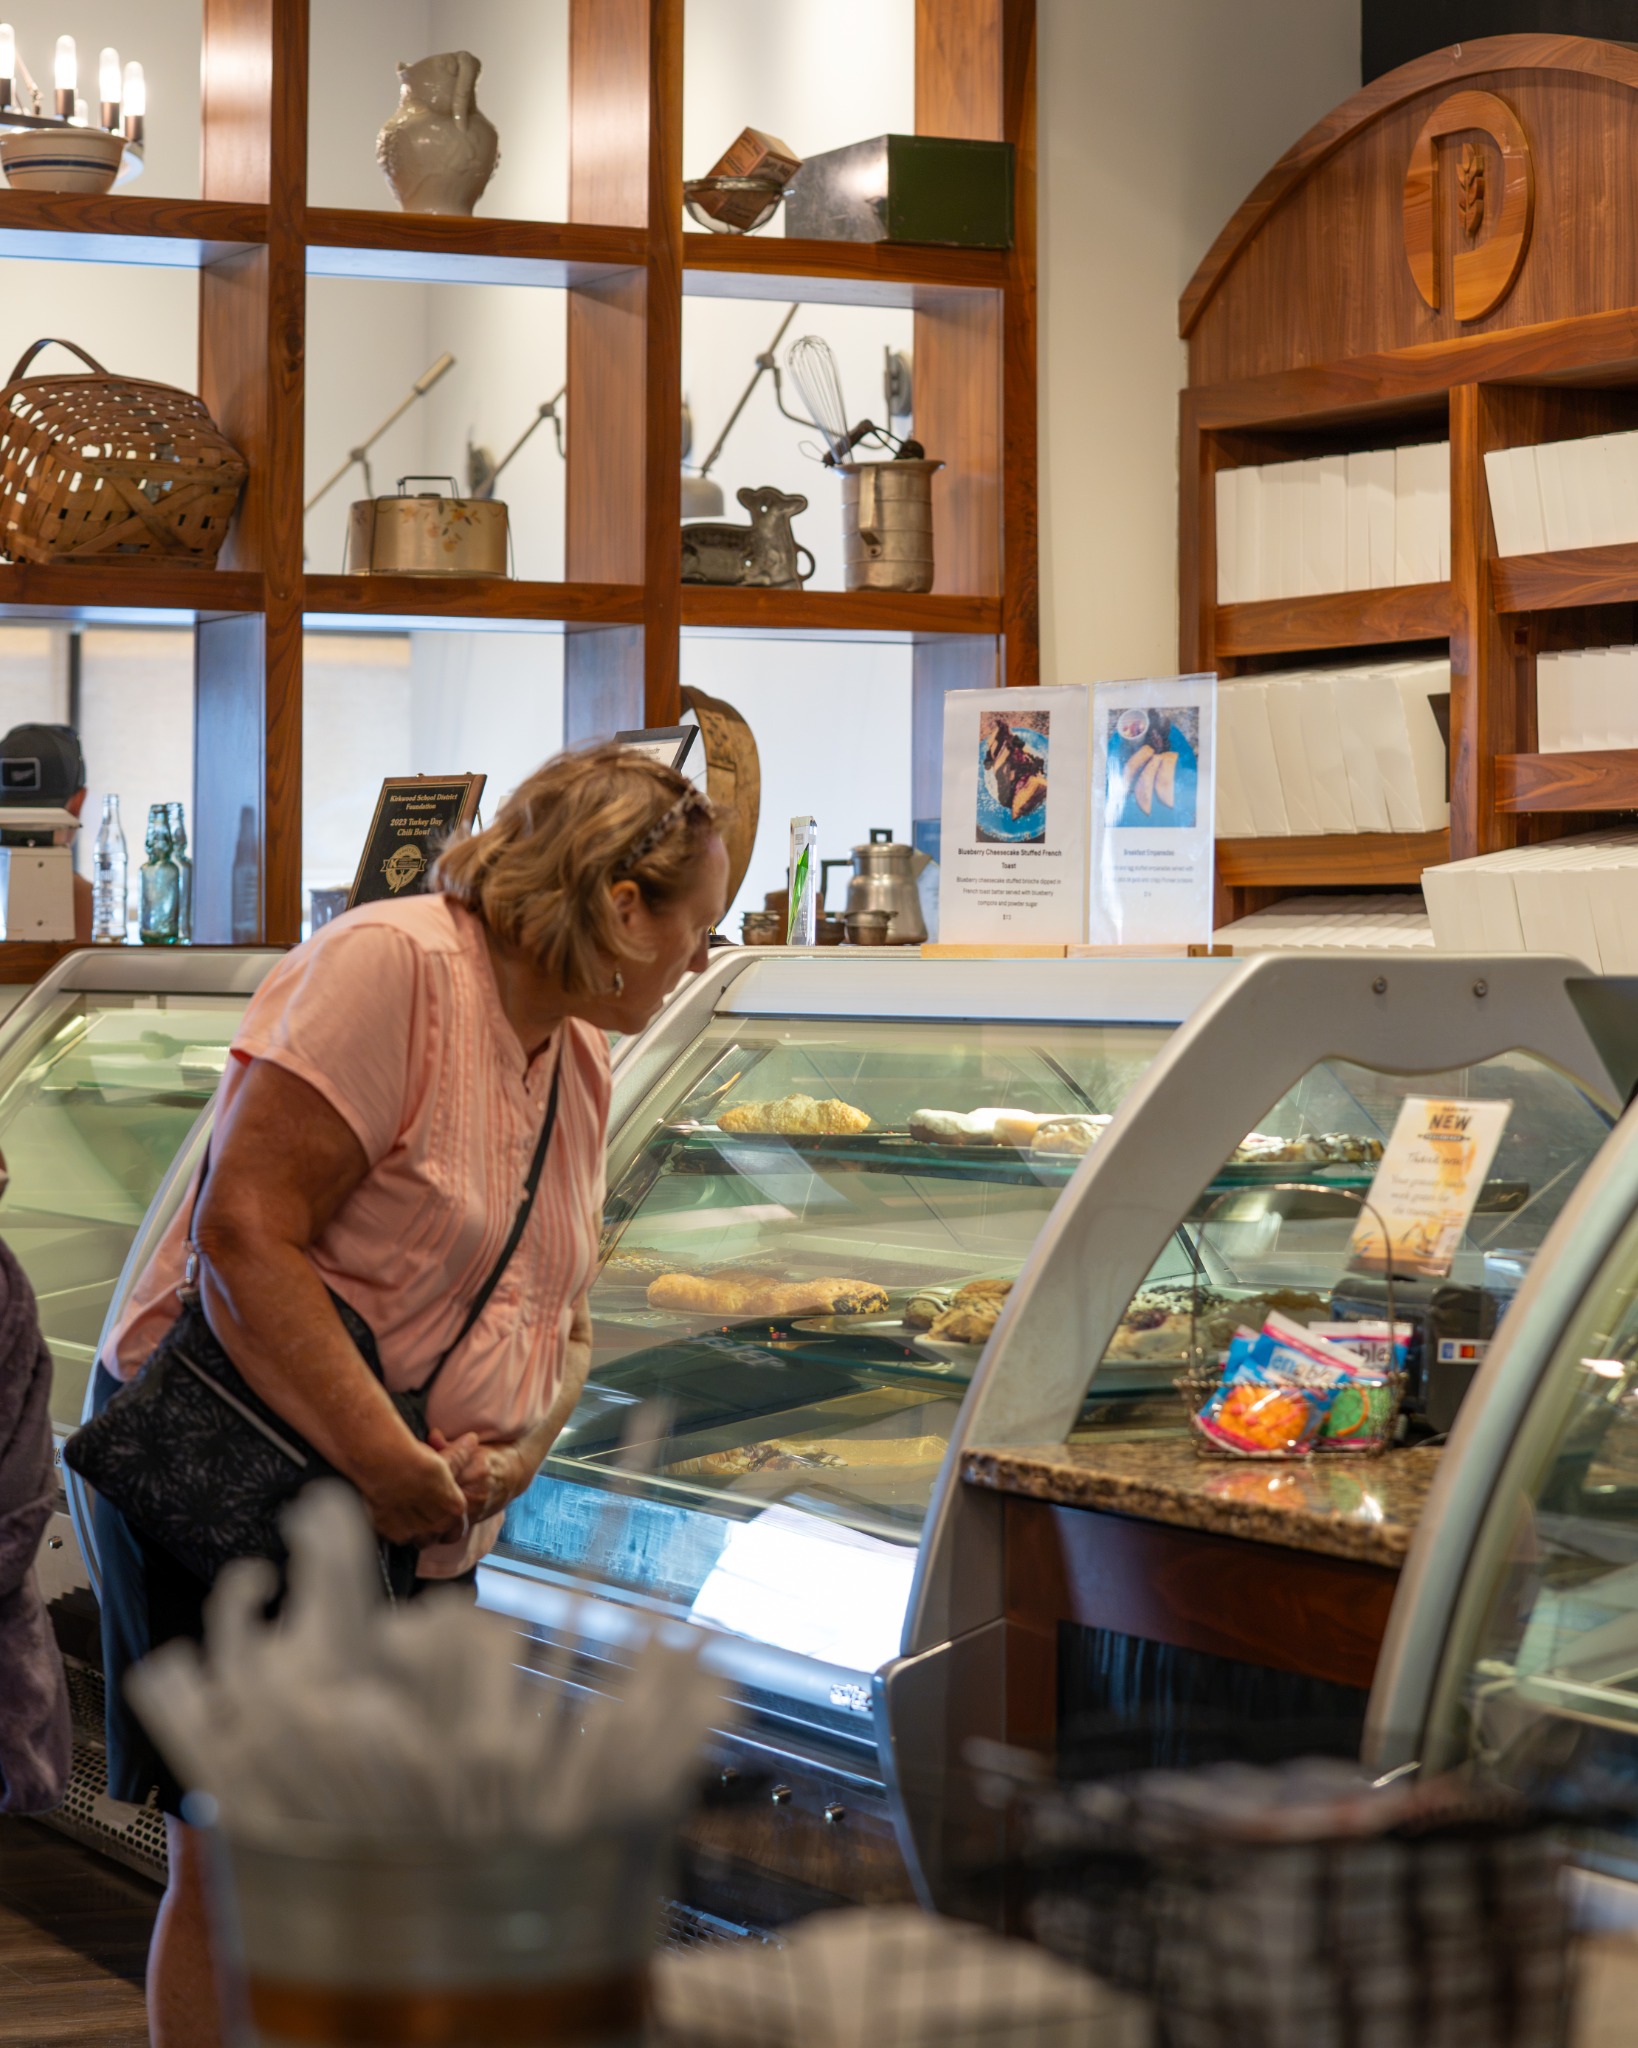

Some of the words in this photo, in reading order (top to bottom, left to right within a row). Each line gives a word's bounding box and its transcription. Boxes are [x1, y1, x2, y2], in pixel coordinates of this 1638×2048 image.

[390, 818, 407, 826] 2023
[409, 817, 430, 827] Turkey
[430, 817, 443, 826] Day
[397, 828, 413, 836] Chili
[958, 848, 984, 856] Blueberry
[986, 848, 1020, 856] Cheesecake
[1021, 849, 1041, 857] Stuffed
[1042, 849, 1062, 857] French
[956, 876, 978, 884] Blueberry
[1031, 889, 1054, 897] blueberry
[1429, 1115, 1470, 1131] NEW
